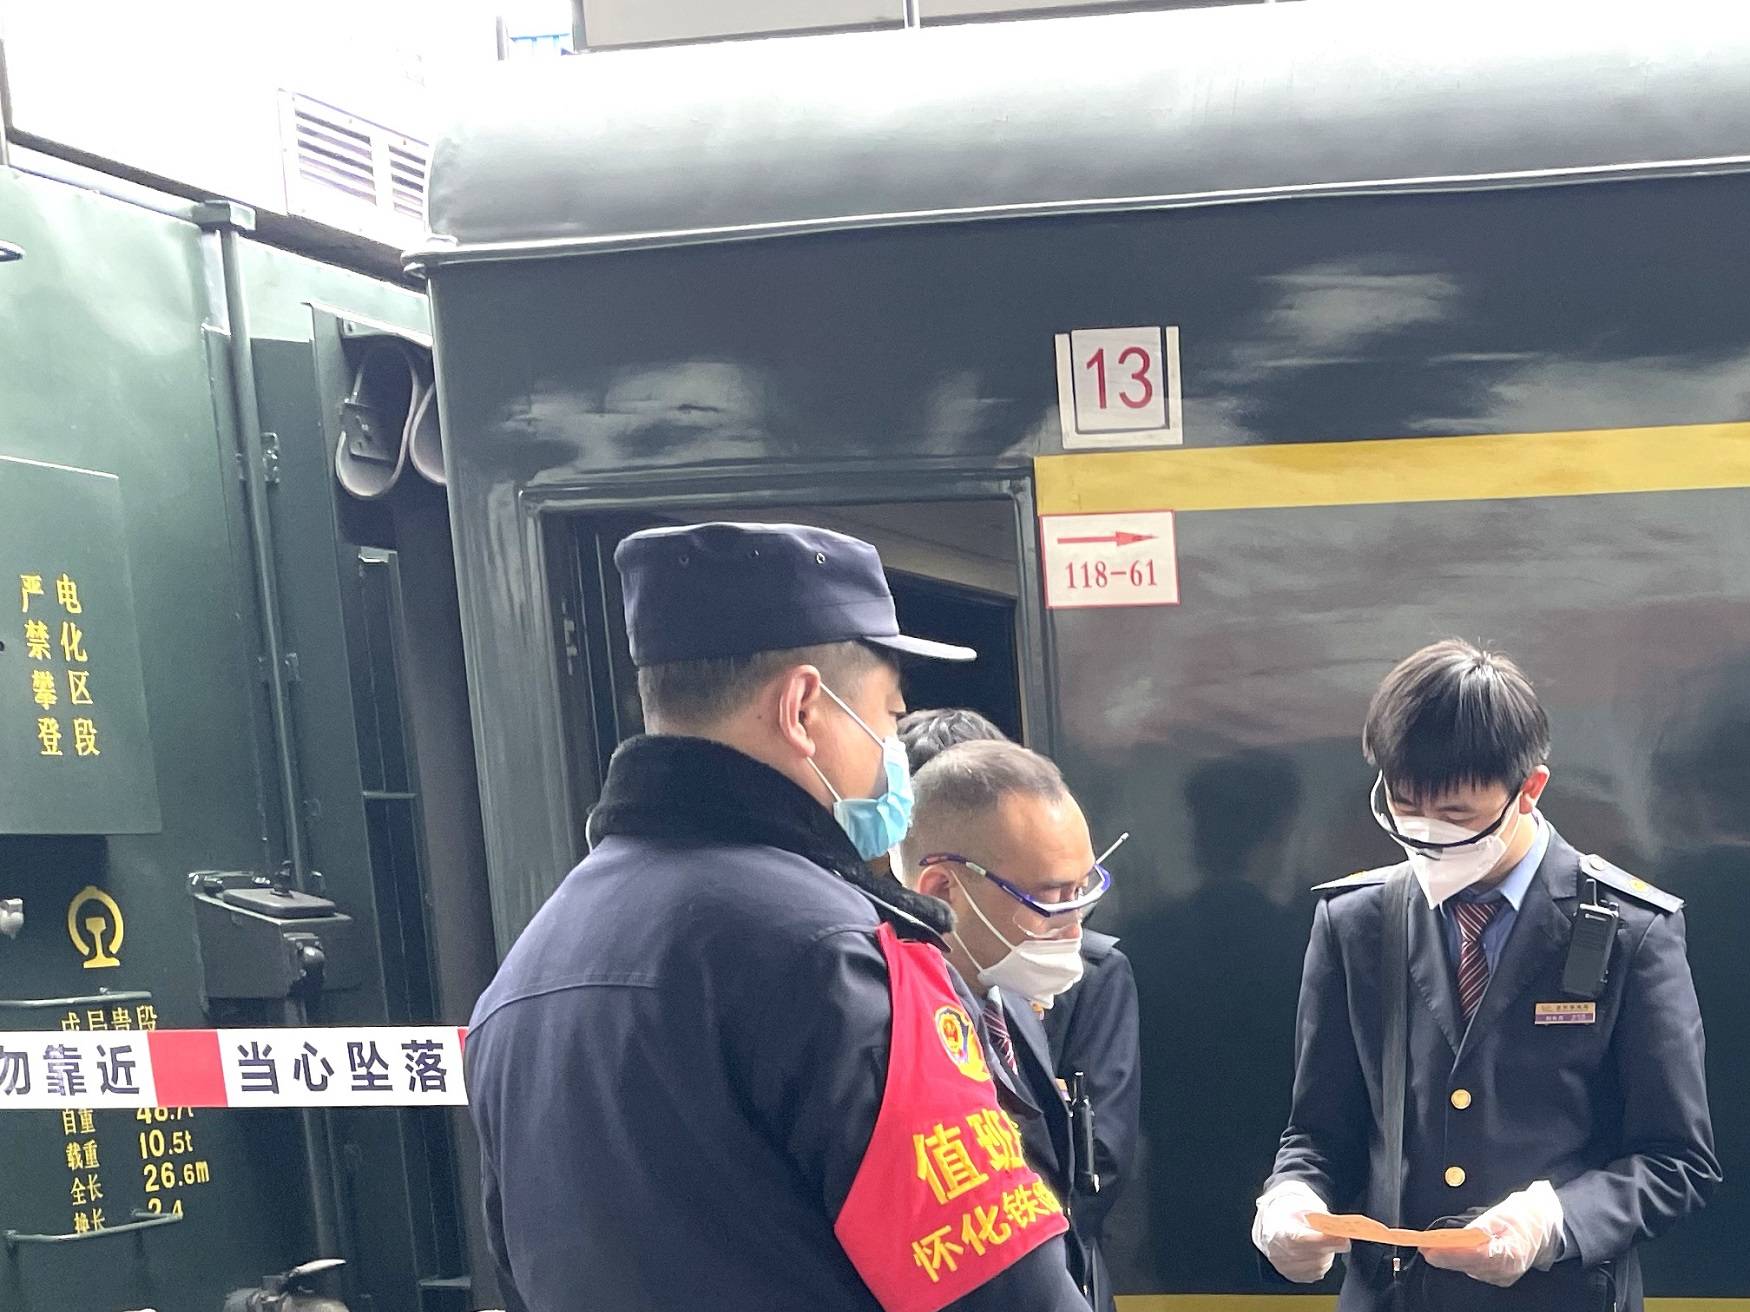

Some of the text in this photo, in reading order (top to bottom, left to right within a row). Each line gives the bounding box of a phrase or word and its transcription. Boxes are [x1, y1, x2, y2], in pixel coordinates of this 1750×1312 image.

[1086, 347, 1153, 410] 13
[1065, 559, 1157, 589] 118-61
[20, 574, 64, 756] 严禁攀登
[56, 573, 100, 756] 电化区段
[0, 1044, 140, 1096] 勿靠近
[237, 1040, 447, 1094] 当心坠落
[66, 1129, 193, 1171] 载重 10.5t
[70, 1161, 210, 1206] 全长 26.6m
